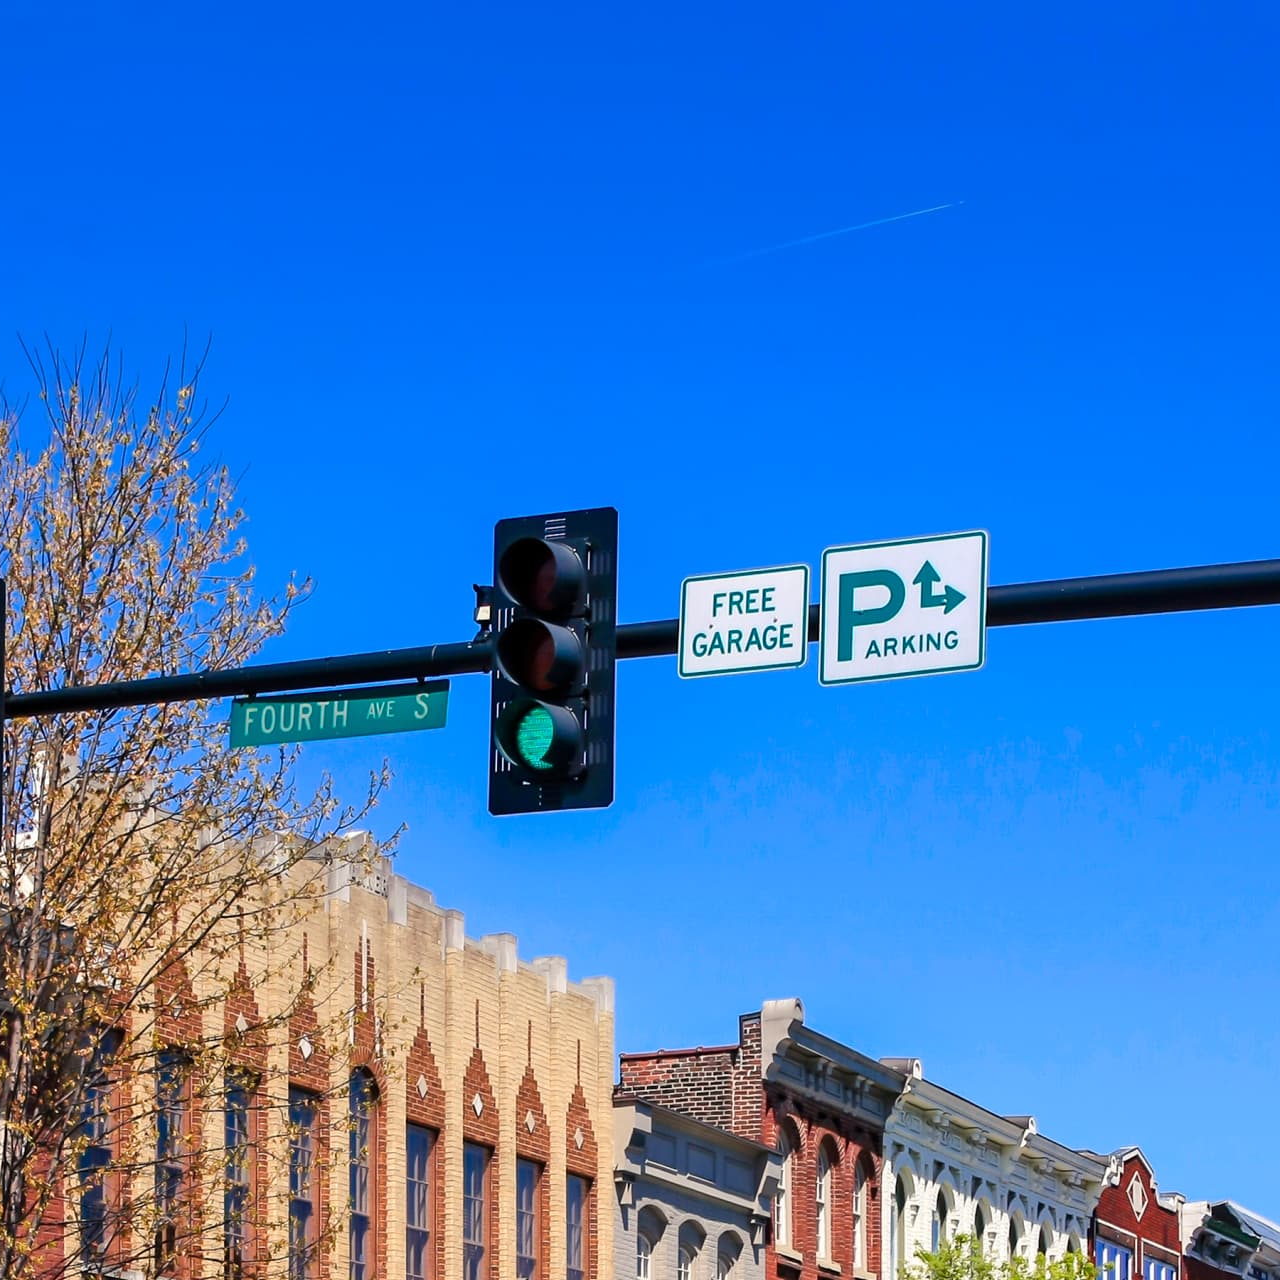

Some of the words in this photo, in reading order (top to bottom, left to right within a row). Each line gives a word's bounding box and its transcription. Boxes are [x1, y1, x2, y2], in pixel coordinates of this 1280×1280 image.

[712, 587, 776, 617] FREE
[837, 569, 959, 662] PARKING
[692, 623, 794, 657] GARAGE
[244, 700, 349, 736] FOURTH
[366, 701, 396, 720] AVE
[414, 693, 430, 719] S
